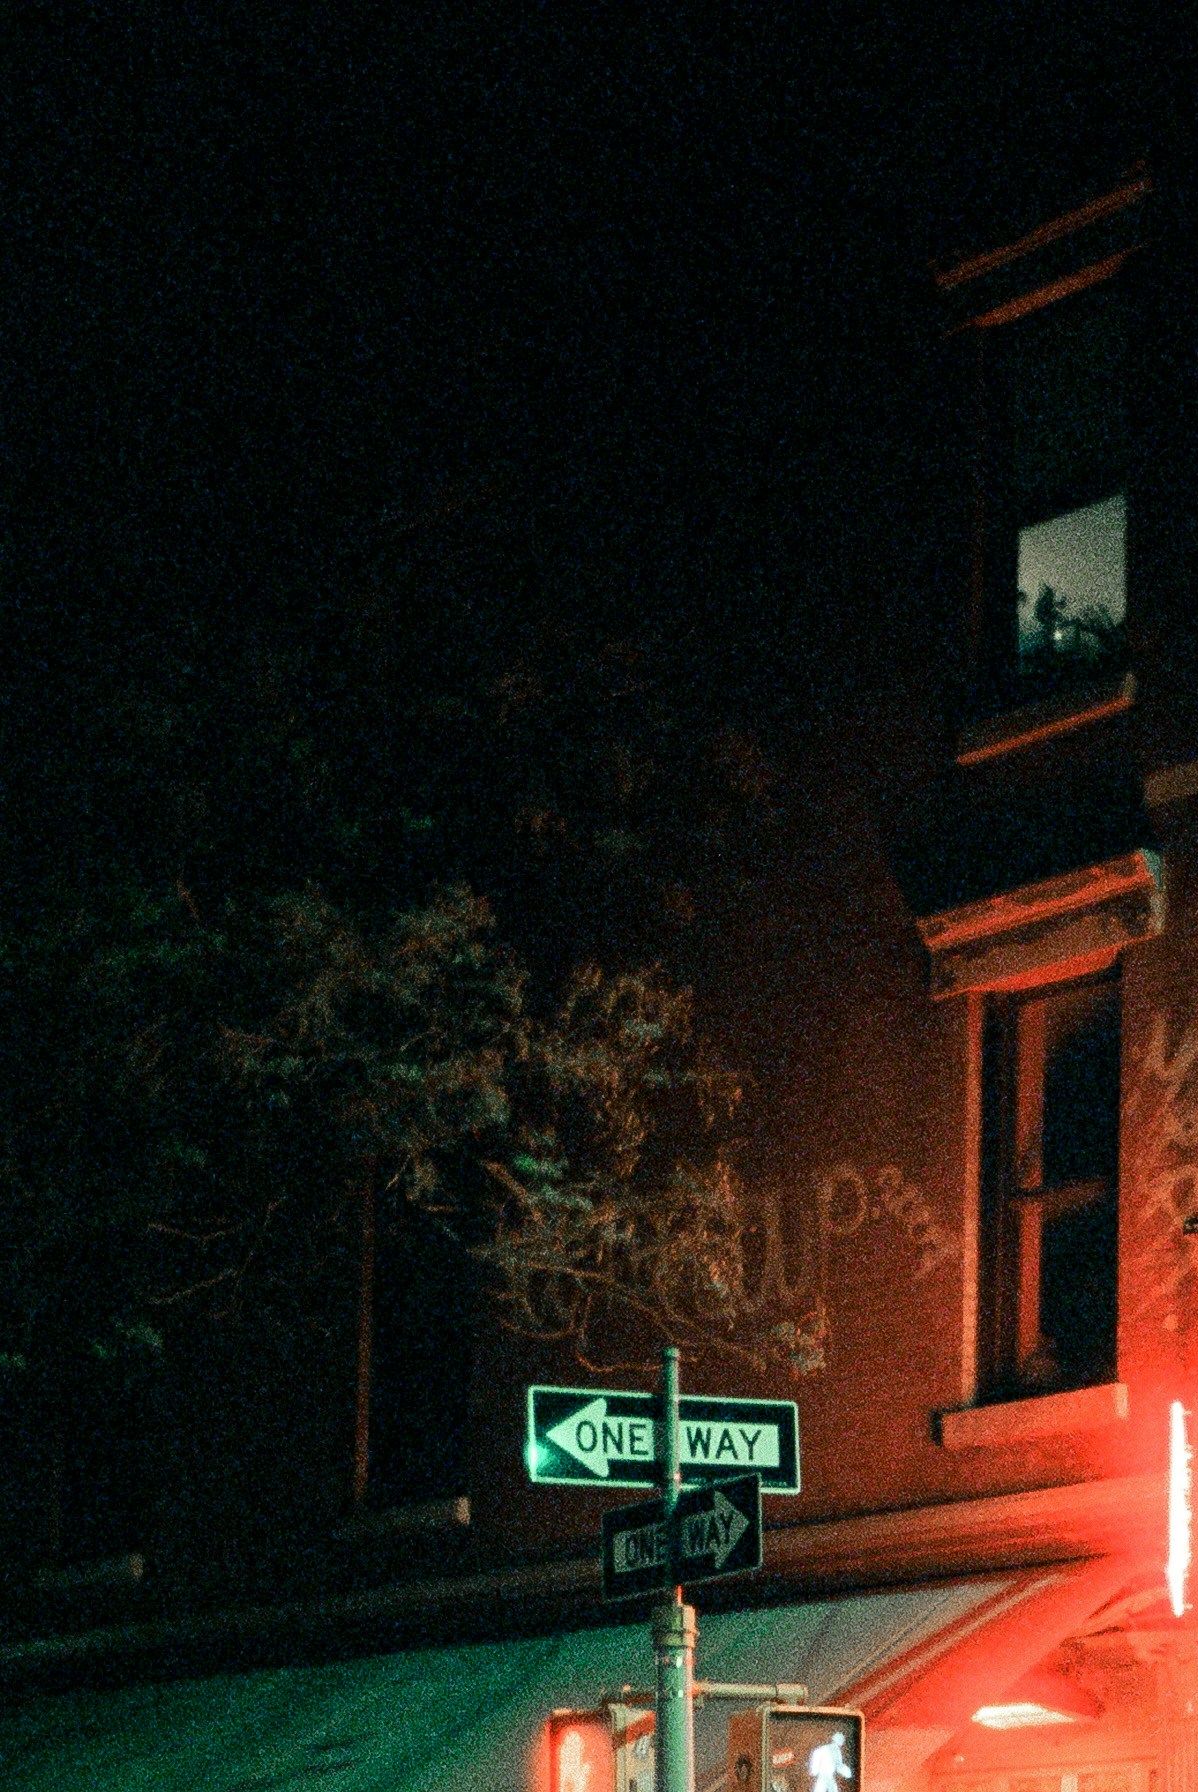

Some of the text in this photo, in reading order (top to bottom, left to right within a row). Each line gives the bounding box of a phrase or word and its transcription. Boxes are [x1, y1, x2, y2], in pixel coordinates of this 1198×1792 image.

[576, 1420, 762, 1461] ONE WAY
[687, 1511, 734, 1552] WAY
